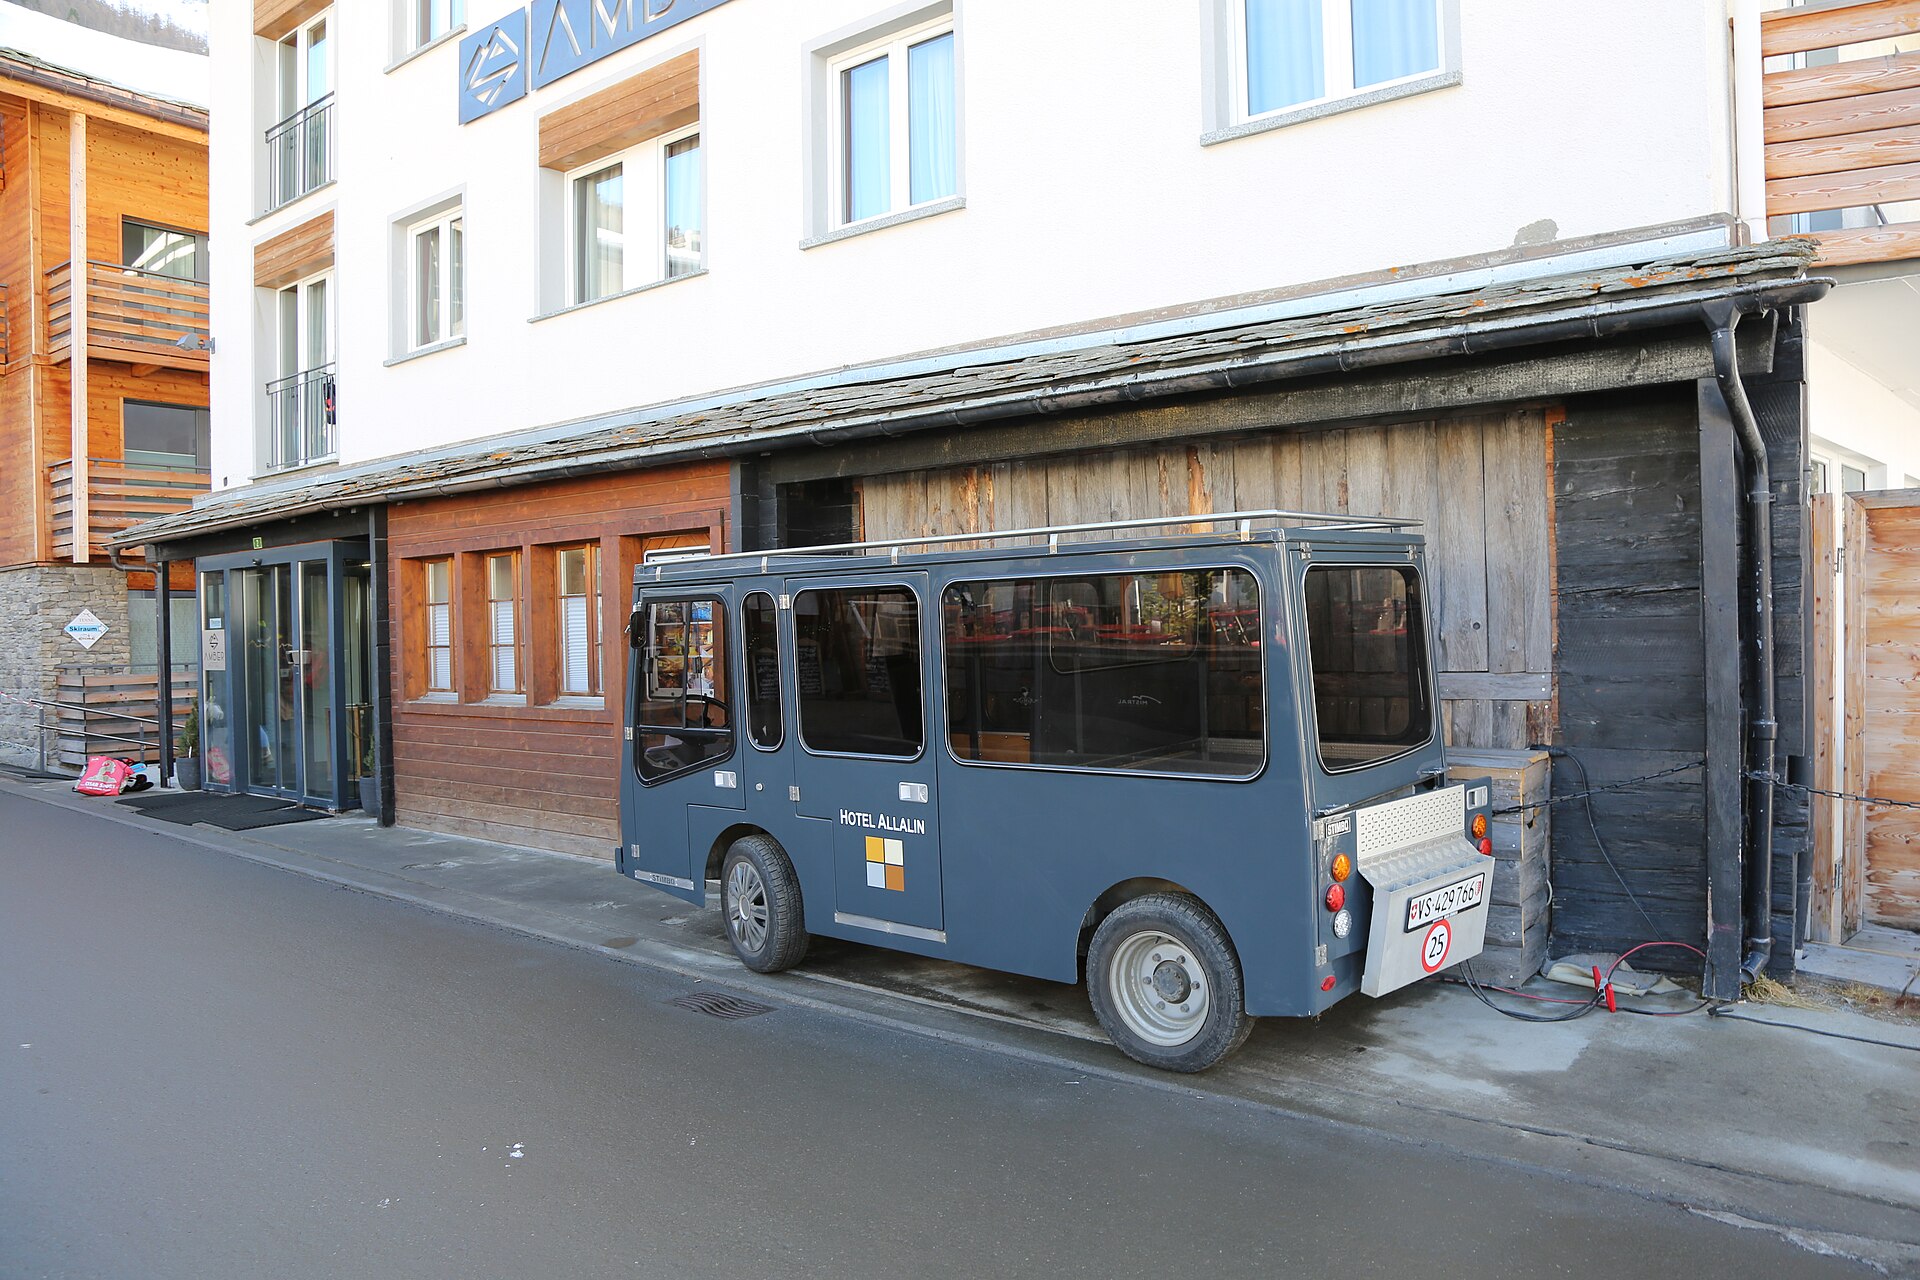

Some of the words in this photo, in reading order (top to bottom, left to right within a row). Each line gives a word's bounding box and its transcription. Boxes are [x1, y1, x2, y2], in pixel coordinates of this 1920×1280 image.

[204, 651, 225, 662] AMBER
[839, 808, 876, 829] HOTEL
[877, 813, 925, 835] ALLALIN
[1327, 819, 1349, 836] STIMBO
[1428, 933, 1445, 959] 25
